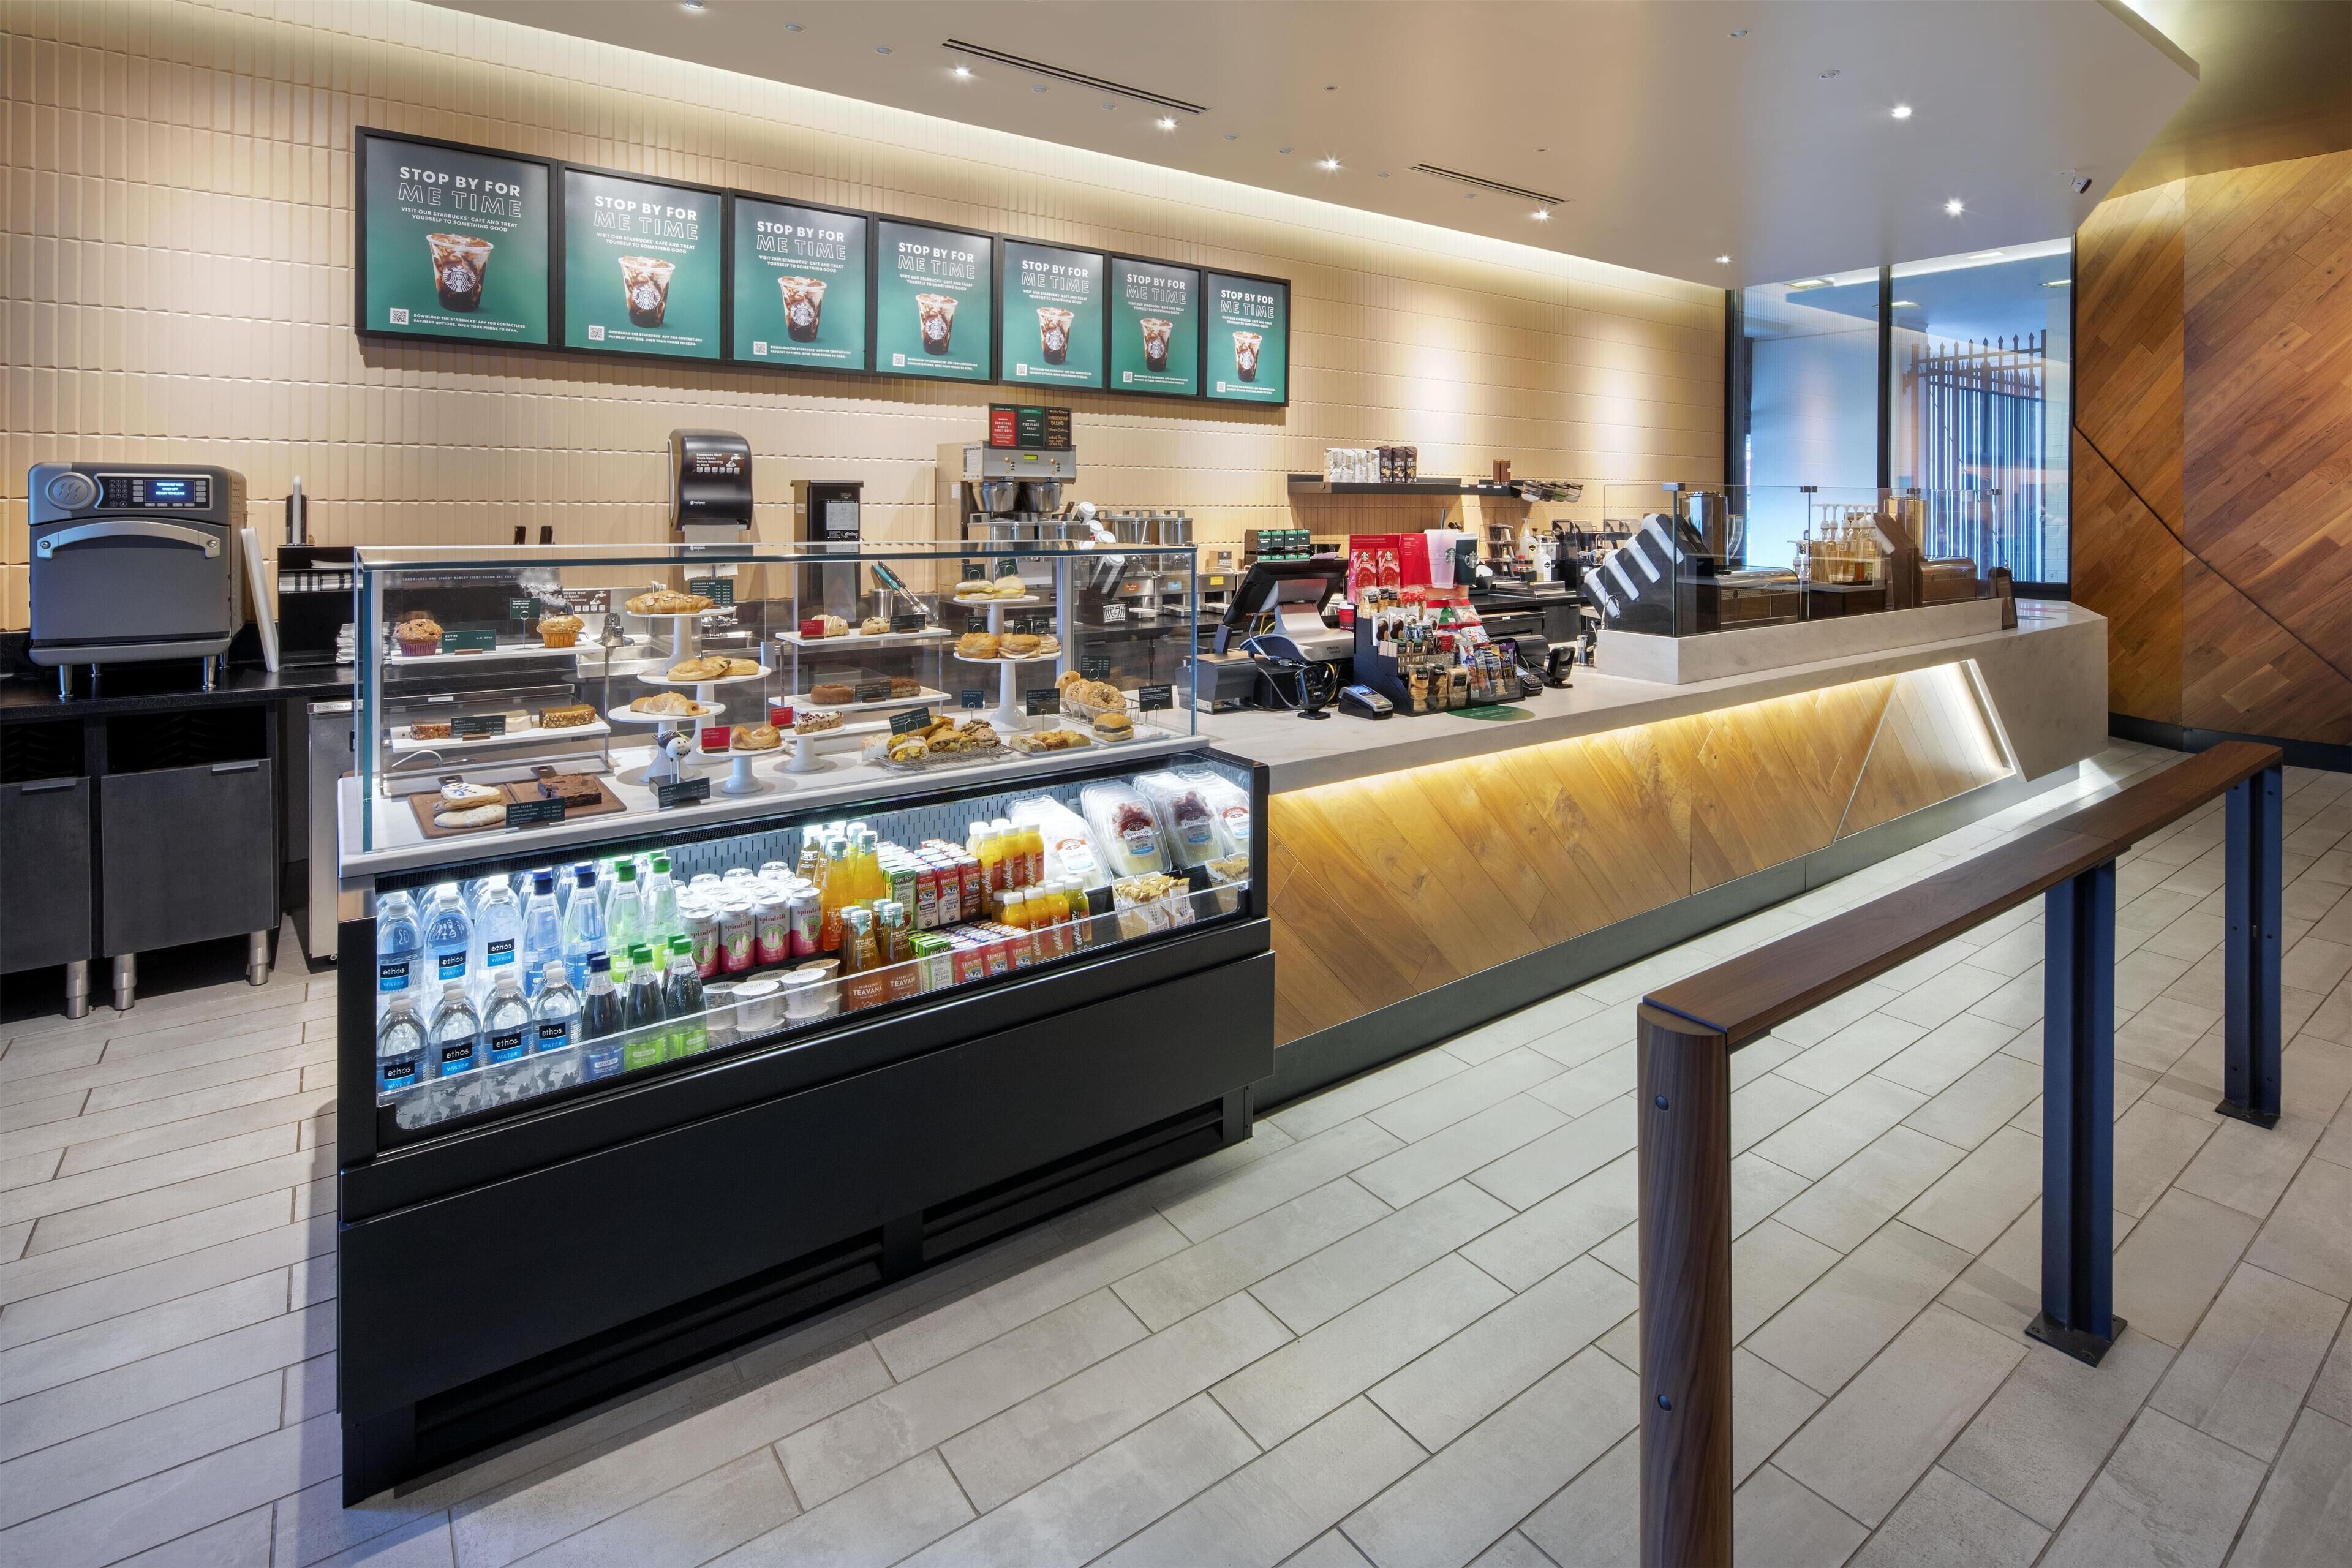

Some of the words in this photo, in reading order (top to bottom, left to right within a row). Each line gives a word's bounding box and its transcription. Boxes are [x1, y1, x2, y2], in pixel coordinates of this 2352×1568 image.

[399, 167, 449, 184] STOP
[456, 176, 478, 189] BY
[485, 181, 519, 197] FOR
[398, 182, 441, 206] ME
[451, 190, 521, 217] TIME
[595, 195, 636, 211] STOP
[642, 203, 662, 215] BY
[667, 206, 696, 221] FOR
[433, 211, 467, 221] STARBUCKS
[453, 220, 488, 229] SOMETHING
[594, 209, 630, 231] ME
[639, 216, 698, 240] TIME
[758, 221, 793, 235] STOP
[798, 226, 815, 238] BY
[819, 229, 844, 242] FOR
[757, 234, 788, 253] ME
[795, 239, 845, 260] TIME
[899, 242, 930, 255] STOP
[933, 247, 948, 258] BY
[952, 251, 974, 262] FOR
[898, 254, 925, 272] ME
[931, 260, 974, 279] TIME
[1022, 260, 1049, 272] STOP
[1053, 265, 1066, 274] BY
[1069, 267, 1088, 277] FOR
[1022, 271, 1045, 287] ME
[1050, 276, 1089, 293] TIME
[1127, 273, 1151, 284] STOP
[1153, 277, 1165, 287] BY
[1167, 279, 1185, 289] FOR
[1126, 284, 1147, 300] ME
[1152, 288, 1186, 304] TIME
[1221, 289, 1242, 300] STOP
[1245, 293, 1255, 301] BY
[1257, 295, 1273, 304] FOR
[1220, 300, 1239, 314] ME
[1243, 303, 1273, 318] TIME
[725, 920, 752, 932] spindrift
[760, 913, 786, 924] spindrift
[491, 943, 512, 951] ethos
[442, 955, 464, 965] ethos
[383, 967, 405, 976] ethos
[853, 986, 882, 996] TEAVANA
[542, 1027, 562, 1036] ethos
[496, 1038, 518, 1047] ethos
[446, 1047, 469, 1059] ethos
[388, 1066, 411, 1077] ethos
